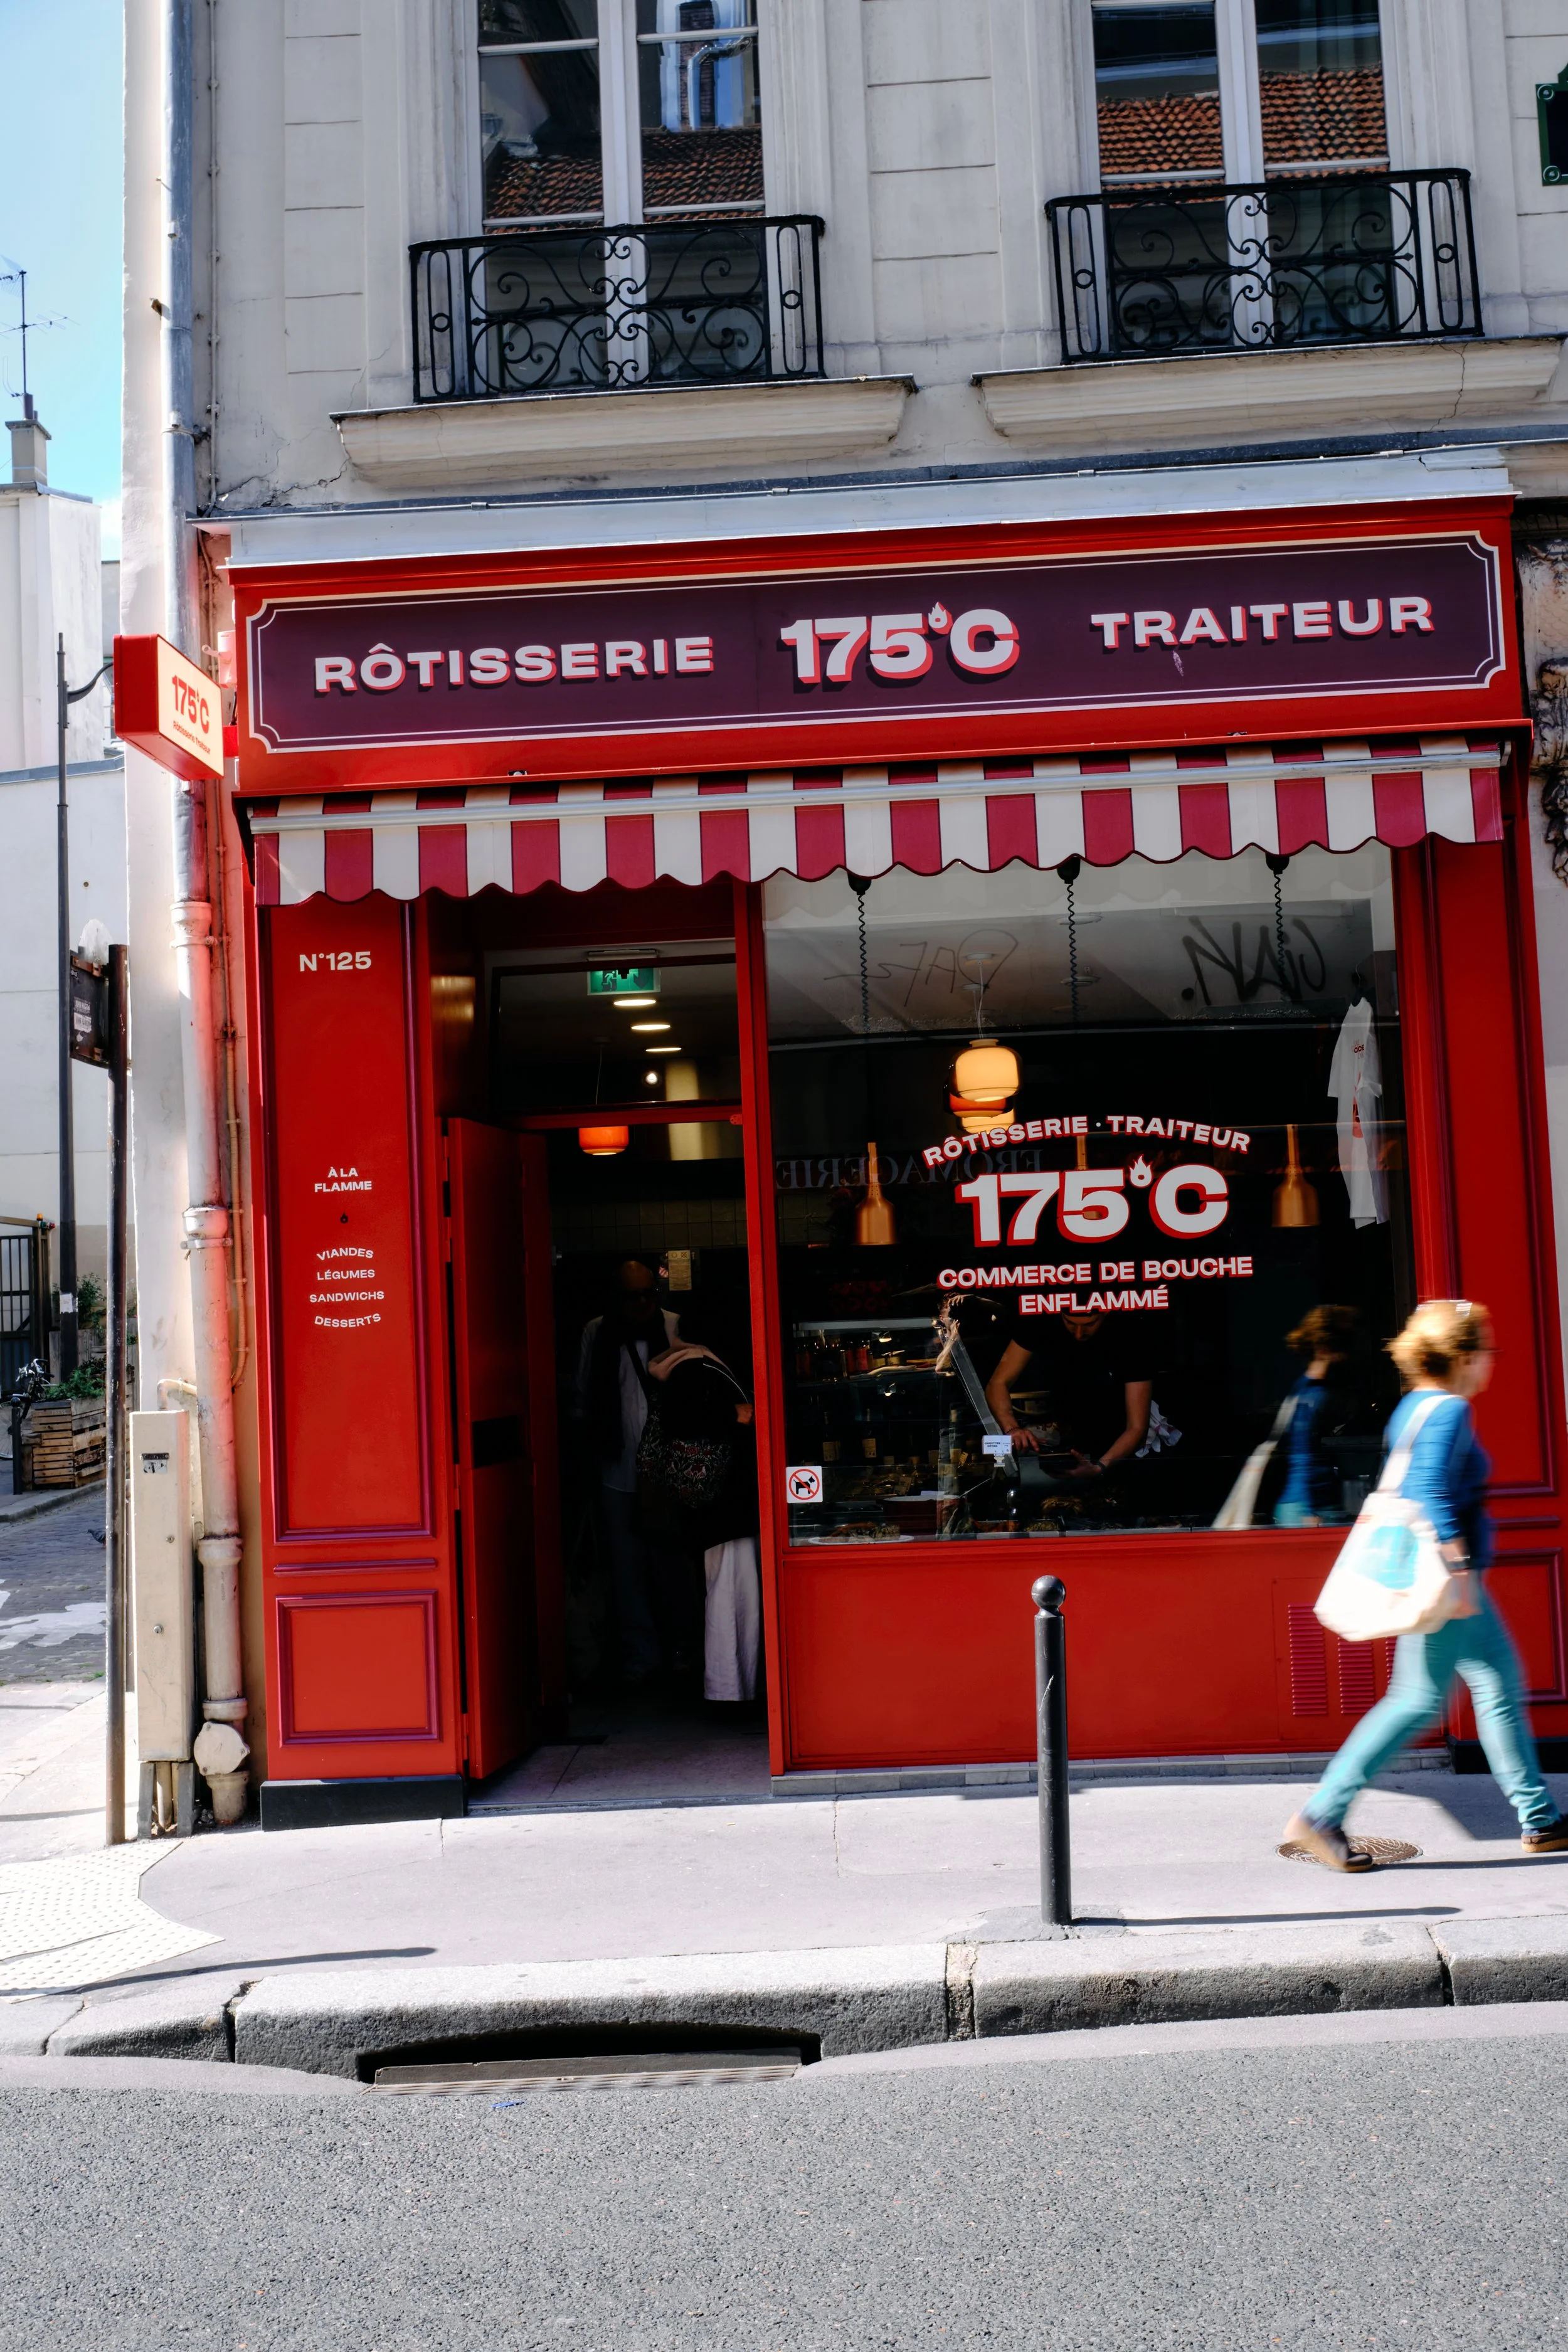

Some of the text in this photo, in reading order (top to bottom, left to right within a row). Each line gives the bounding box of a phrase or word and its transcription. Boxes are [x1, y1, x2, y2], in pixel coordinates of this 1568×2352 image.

[315, 637, 714, 693] RÔTISSERIE
[1091, 597, 1435, 649] TRAITEUR
[300, 951, 372, 972] N°125
[923, 1116, 1251, 1167] RÔTISSERIE TRAITEUR
[328, 1166, 359, 1178] À LA
[314, 1180, 373, 1193] FLAMME
[316, 1248, 374, 1261] VIANDES
[317, 1269, 376, 1281] LÉGUMES
[937, 1256, 1254, 1290] COMMERCE DE BOUCHE
[309, 1290, 385, 1303] SANDWICHS
[1019, 1285, 1169, 1315] ENFLAMMÉ
[314, 1313, 382, 1328] DESSERTS
